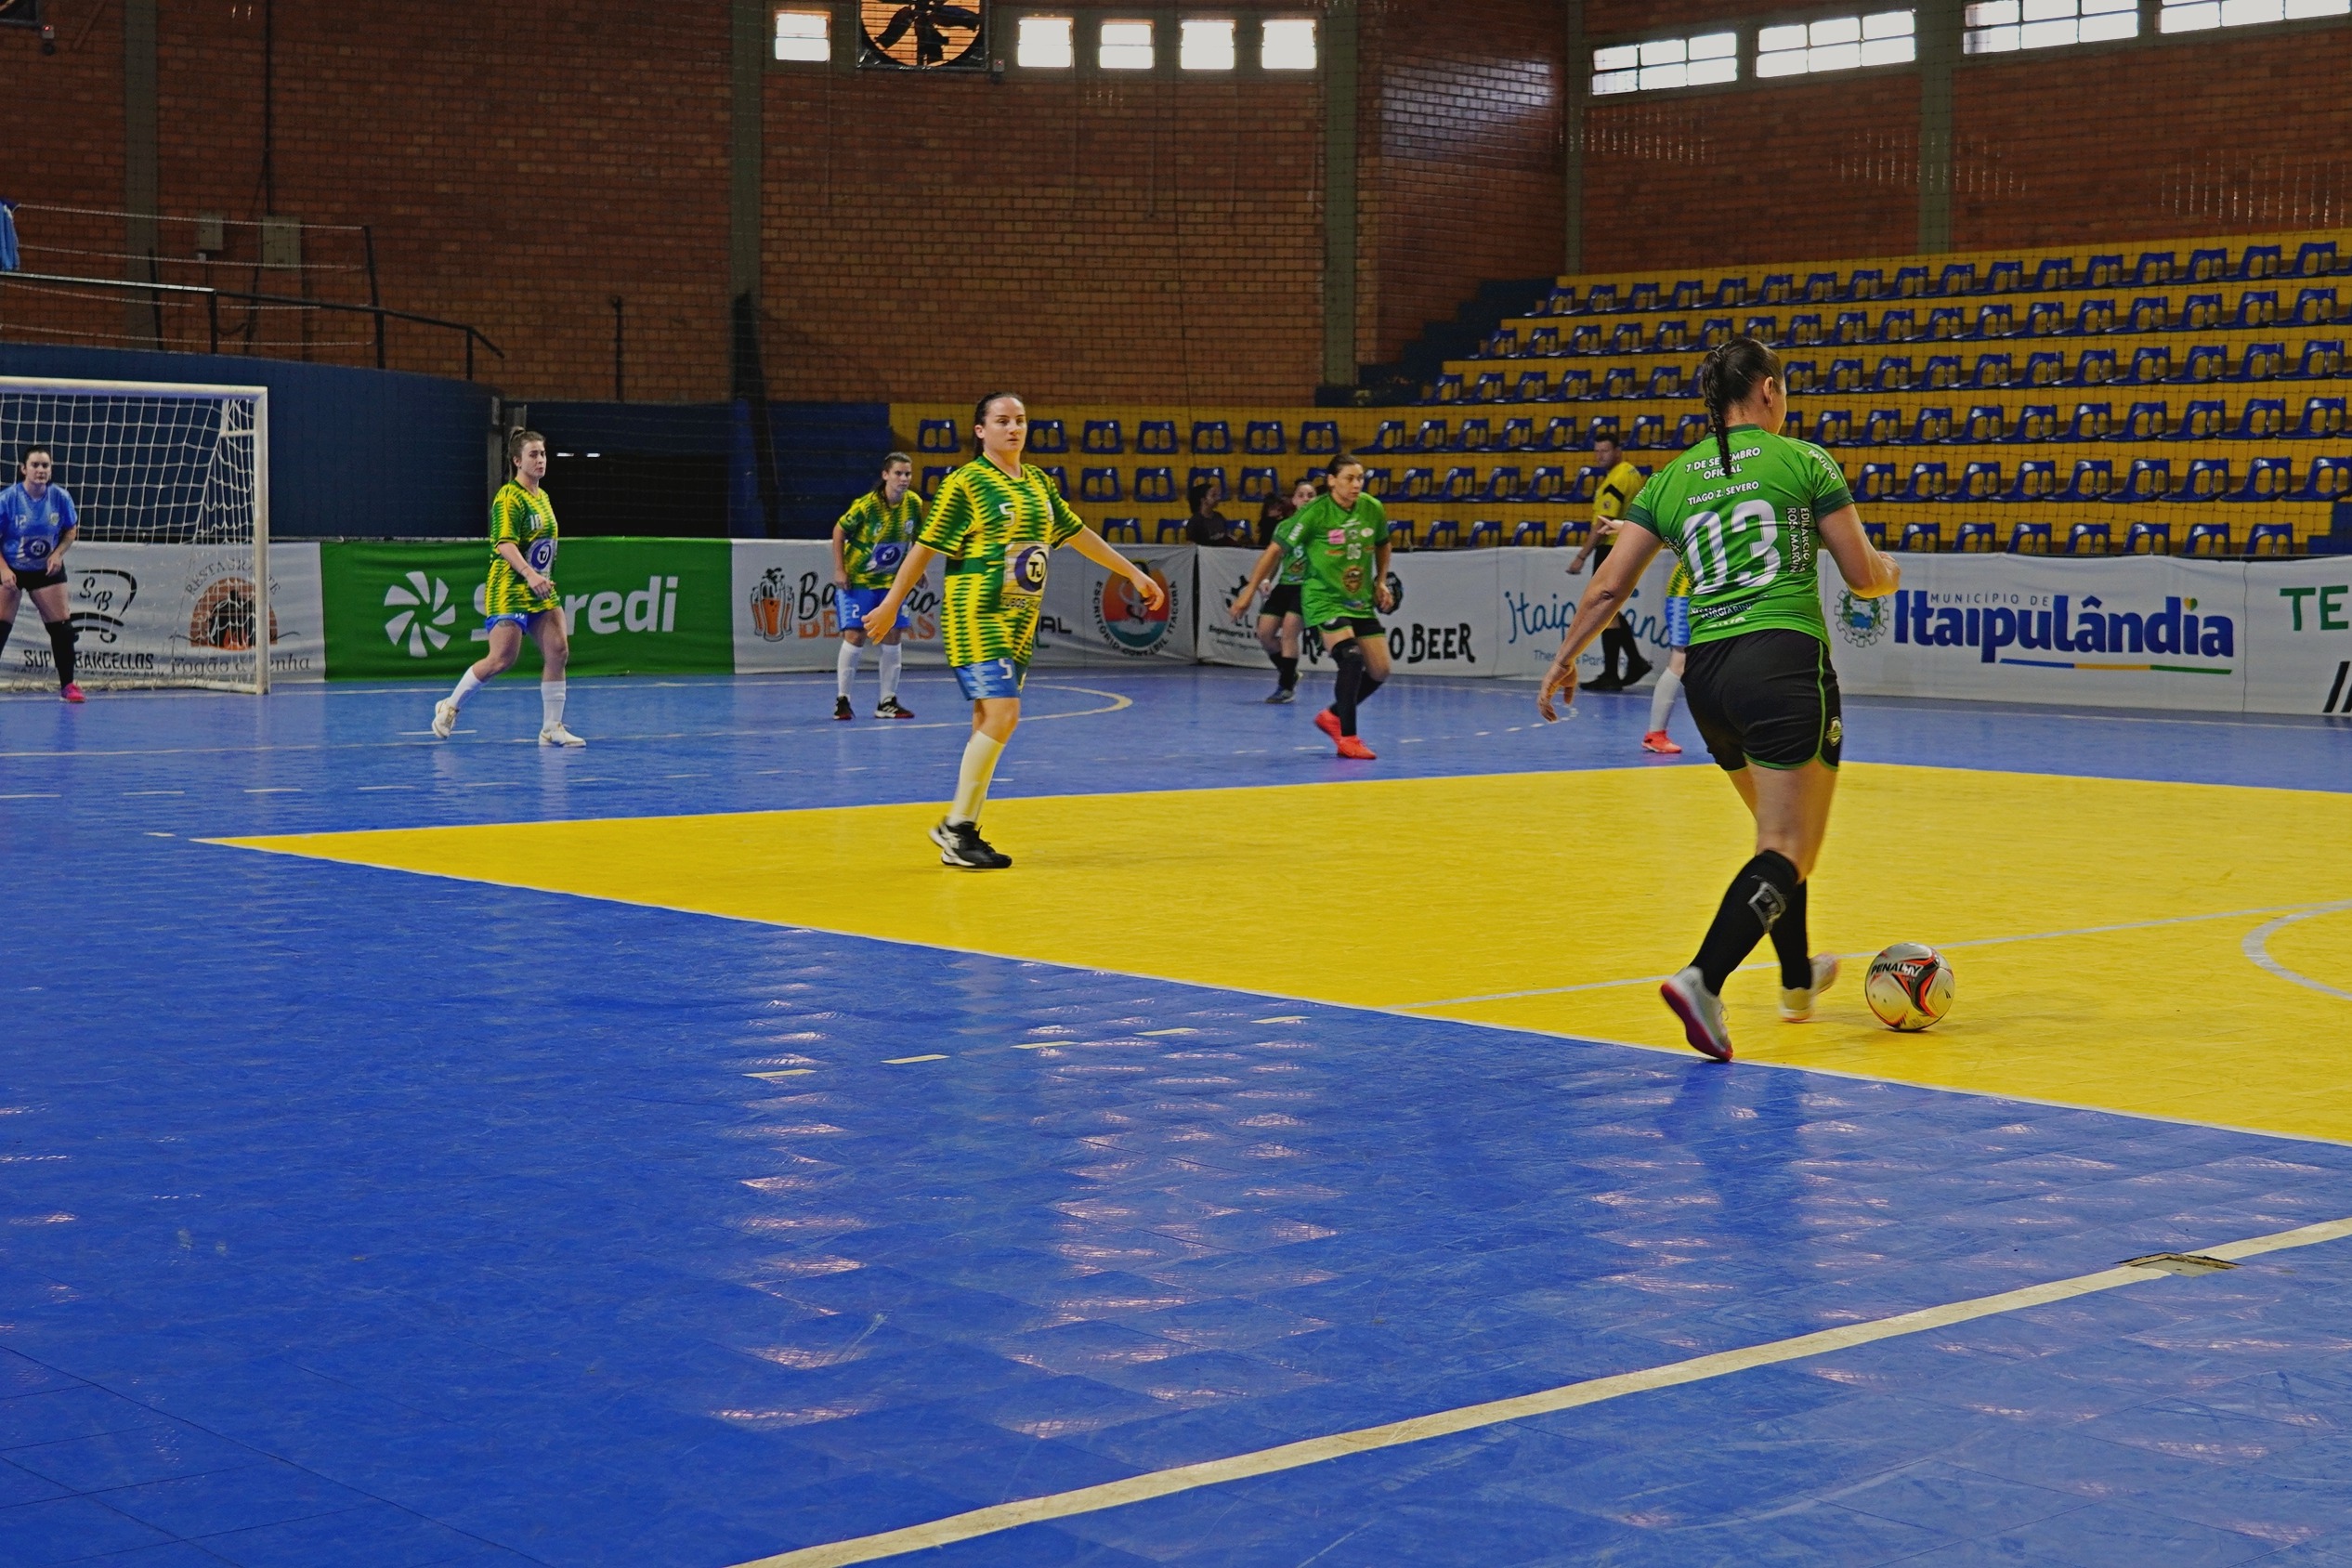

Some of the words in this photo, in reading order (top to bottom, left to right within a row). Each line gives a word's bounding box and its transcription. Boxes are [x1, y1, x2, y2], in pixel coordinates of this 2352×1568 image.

[1685, 464, 1692, 473] 7
[1693, 461, 1708, 471] DE
[1708, 447, 1761, 467] SEMBRO
[1703, 464, 1743, 480] OFICAL
[1687, 490, 1715, 505] TIAGO
[1716, 489, 1724, 498] Z.
[1725, 481, 1759, 496] SEVERO
[999, 501, 1016, 528] 5
[1683, 499, 1782, 595] 03
[1028, 560, 1045, 578] TJ
[851, 604, 861, 619] 2
[1930, 593, 2019, 605] MUNICÍPIO
[2029, 595, 2049, 607] DE
[798, 609, 936, 640] BEAS
[1894, 590, 2234, 663] Itaipulândia
[1408, 623, 1476, 664] BEER
[255, 653, 310, 673] enha
[998, 658, 1014, 679] 5
